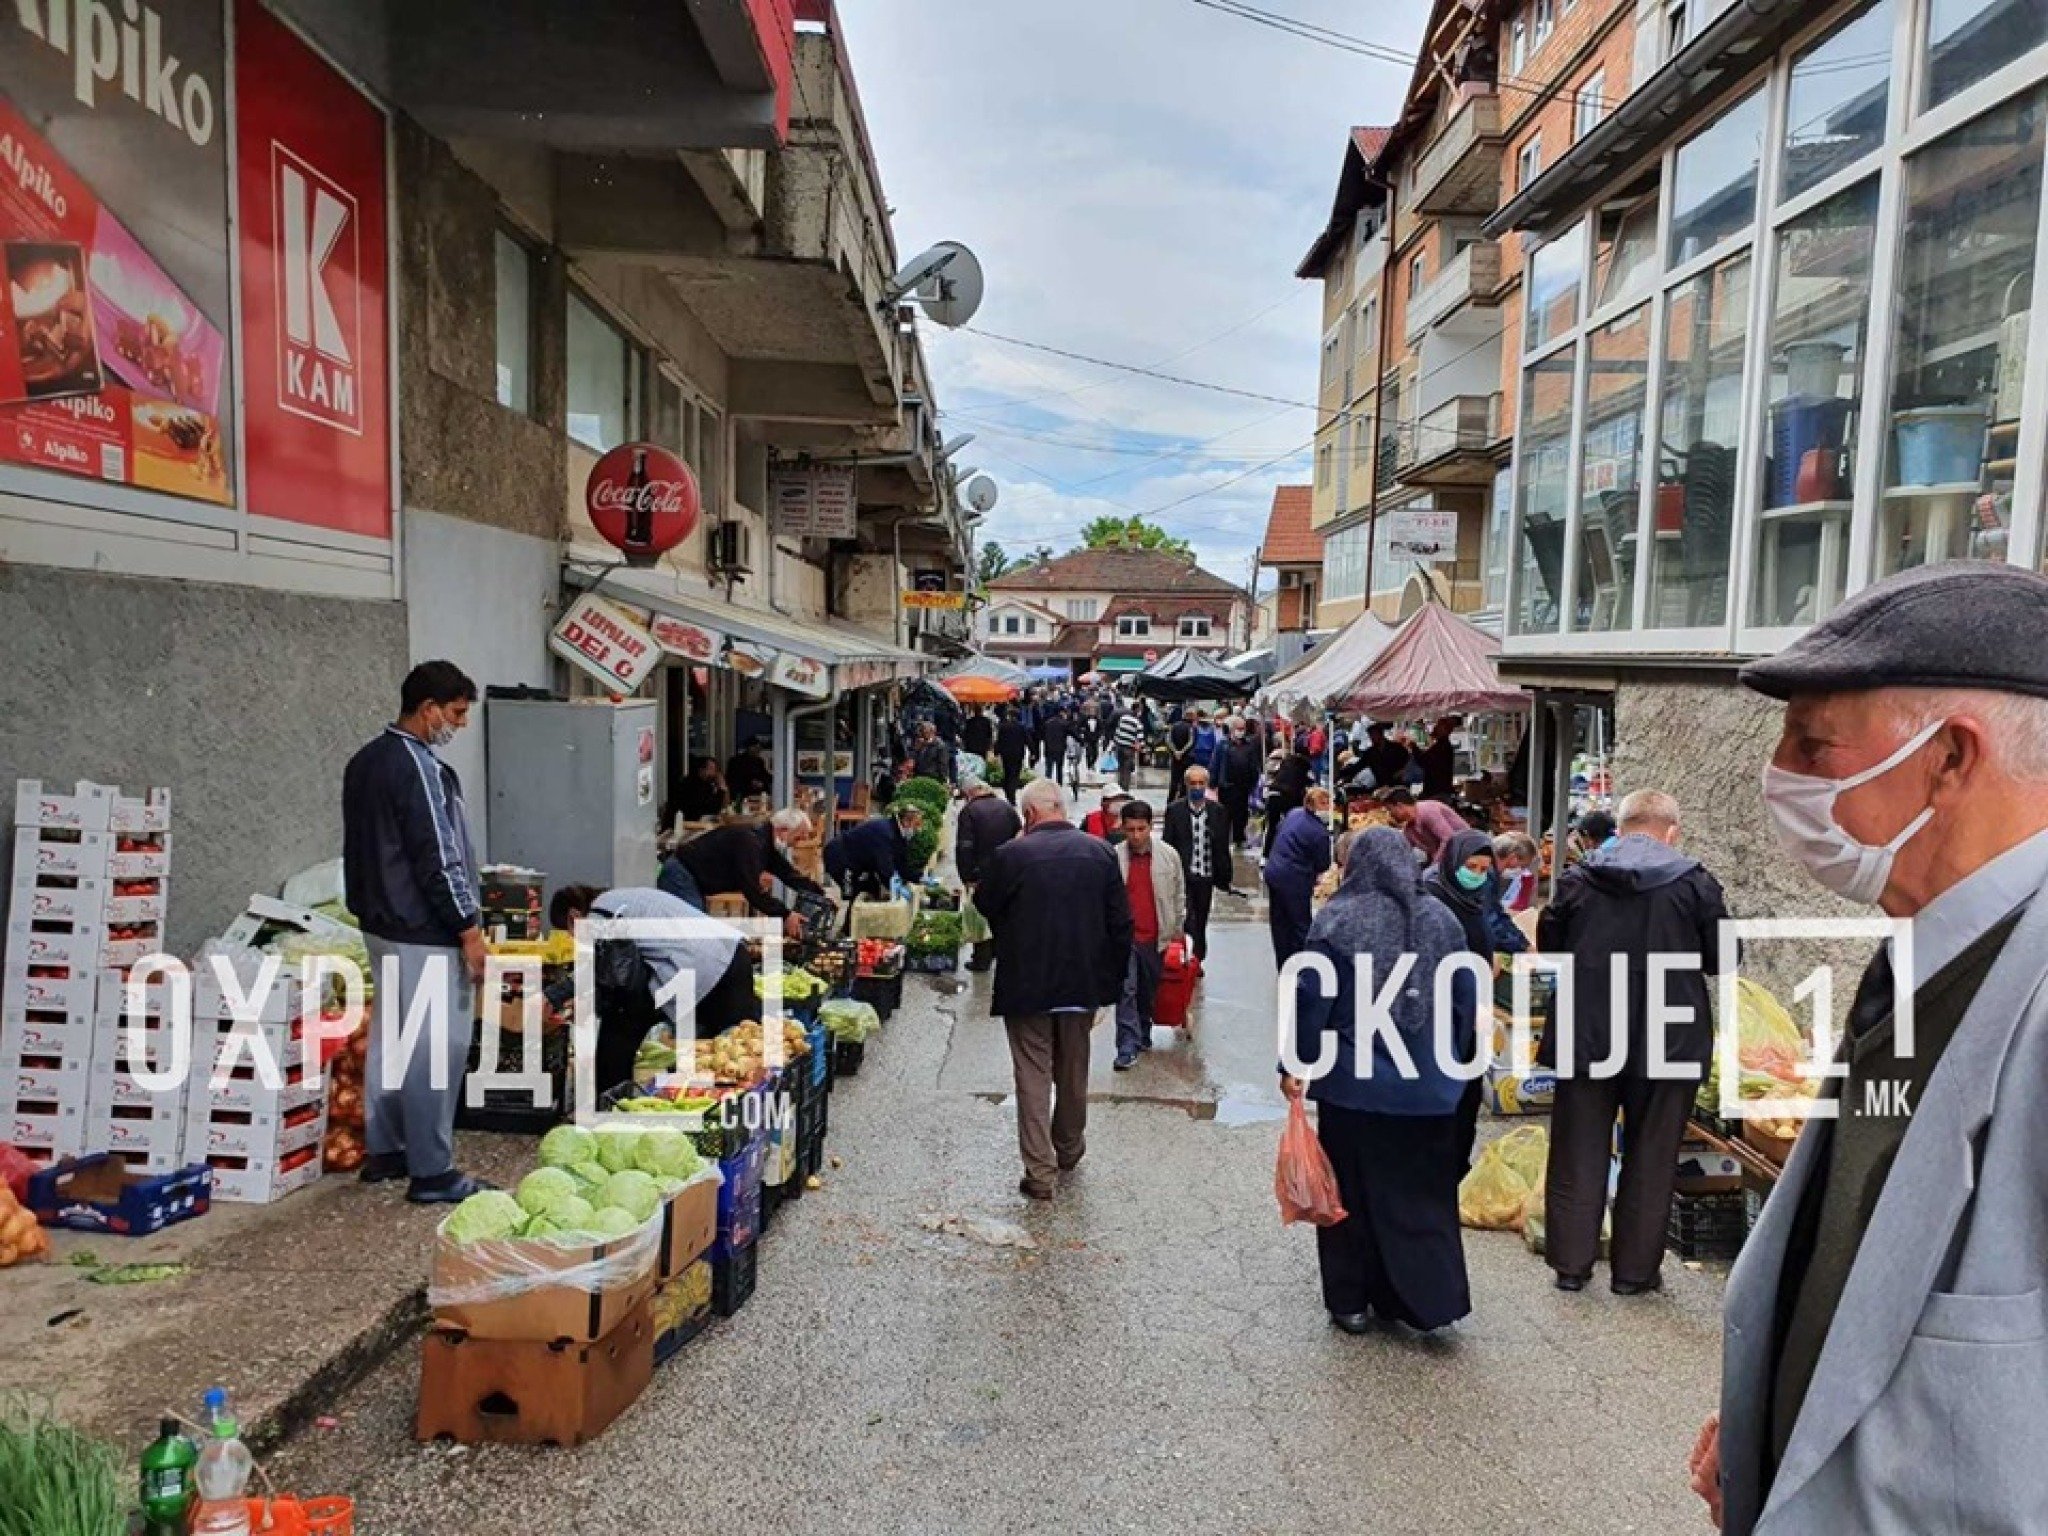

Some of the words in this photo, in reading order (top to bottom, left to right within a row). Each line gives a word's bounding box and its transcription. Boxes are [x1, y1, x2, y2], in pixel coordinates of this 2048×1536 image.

[17, 0, 214, 146] piko
[0, 133, 67, 219] Alpiko
[44, 440, 88, 463] Alpiko
[592, 477, 686, 513] Coca-Cola
